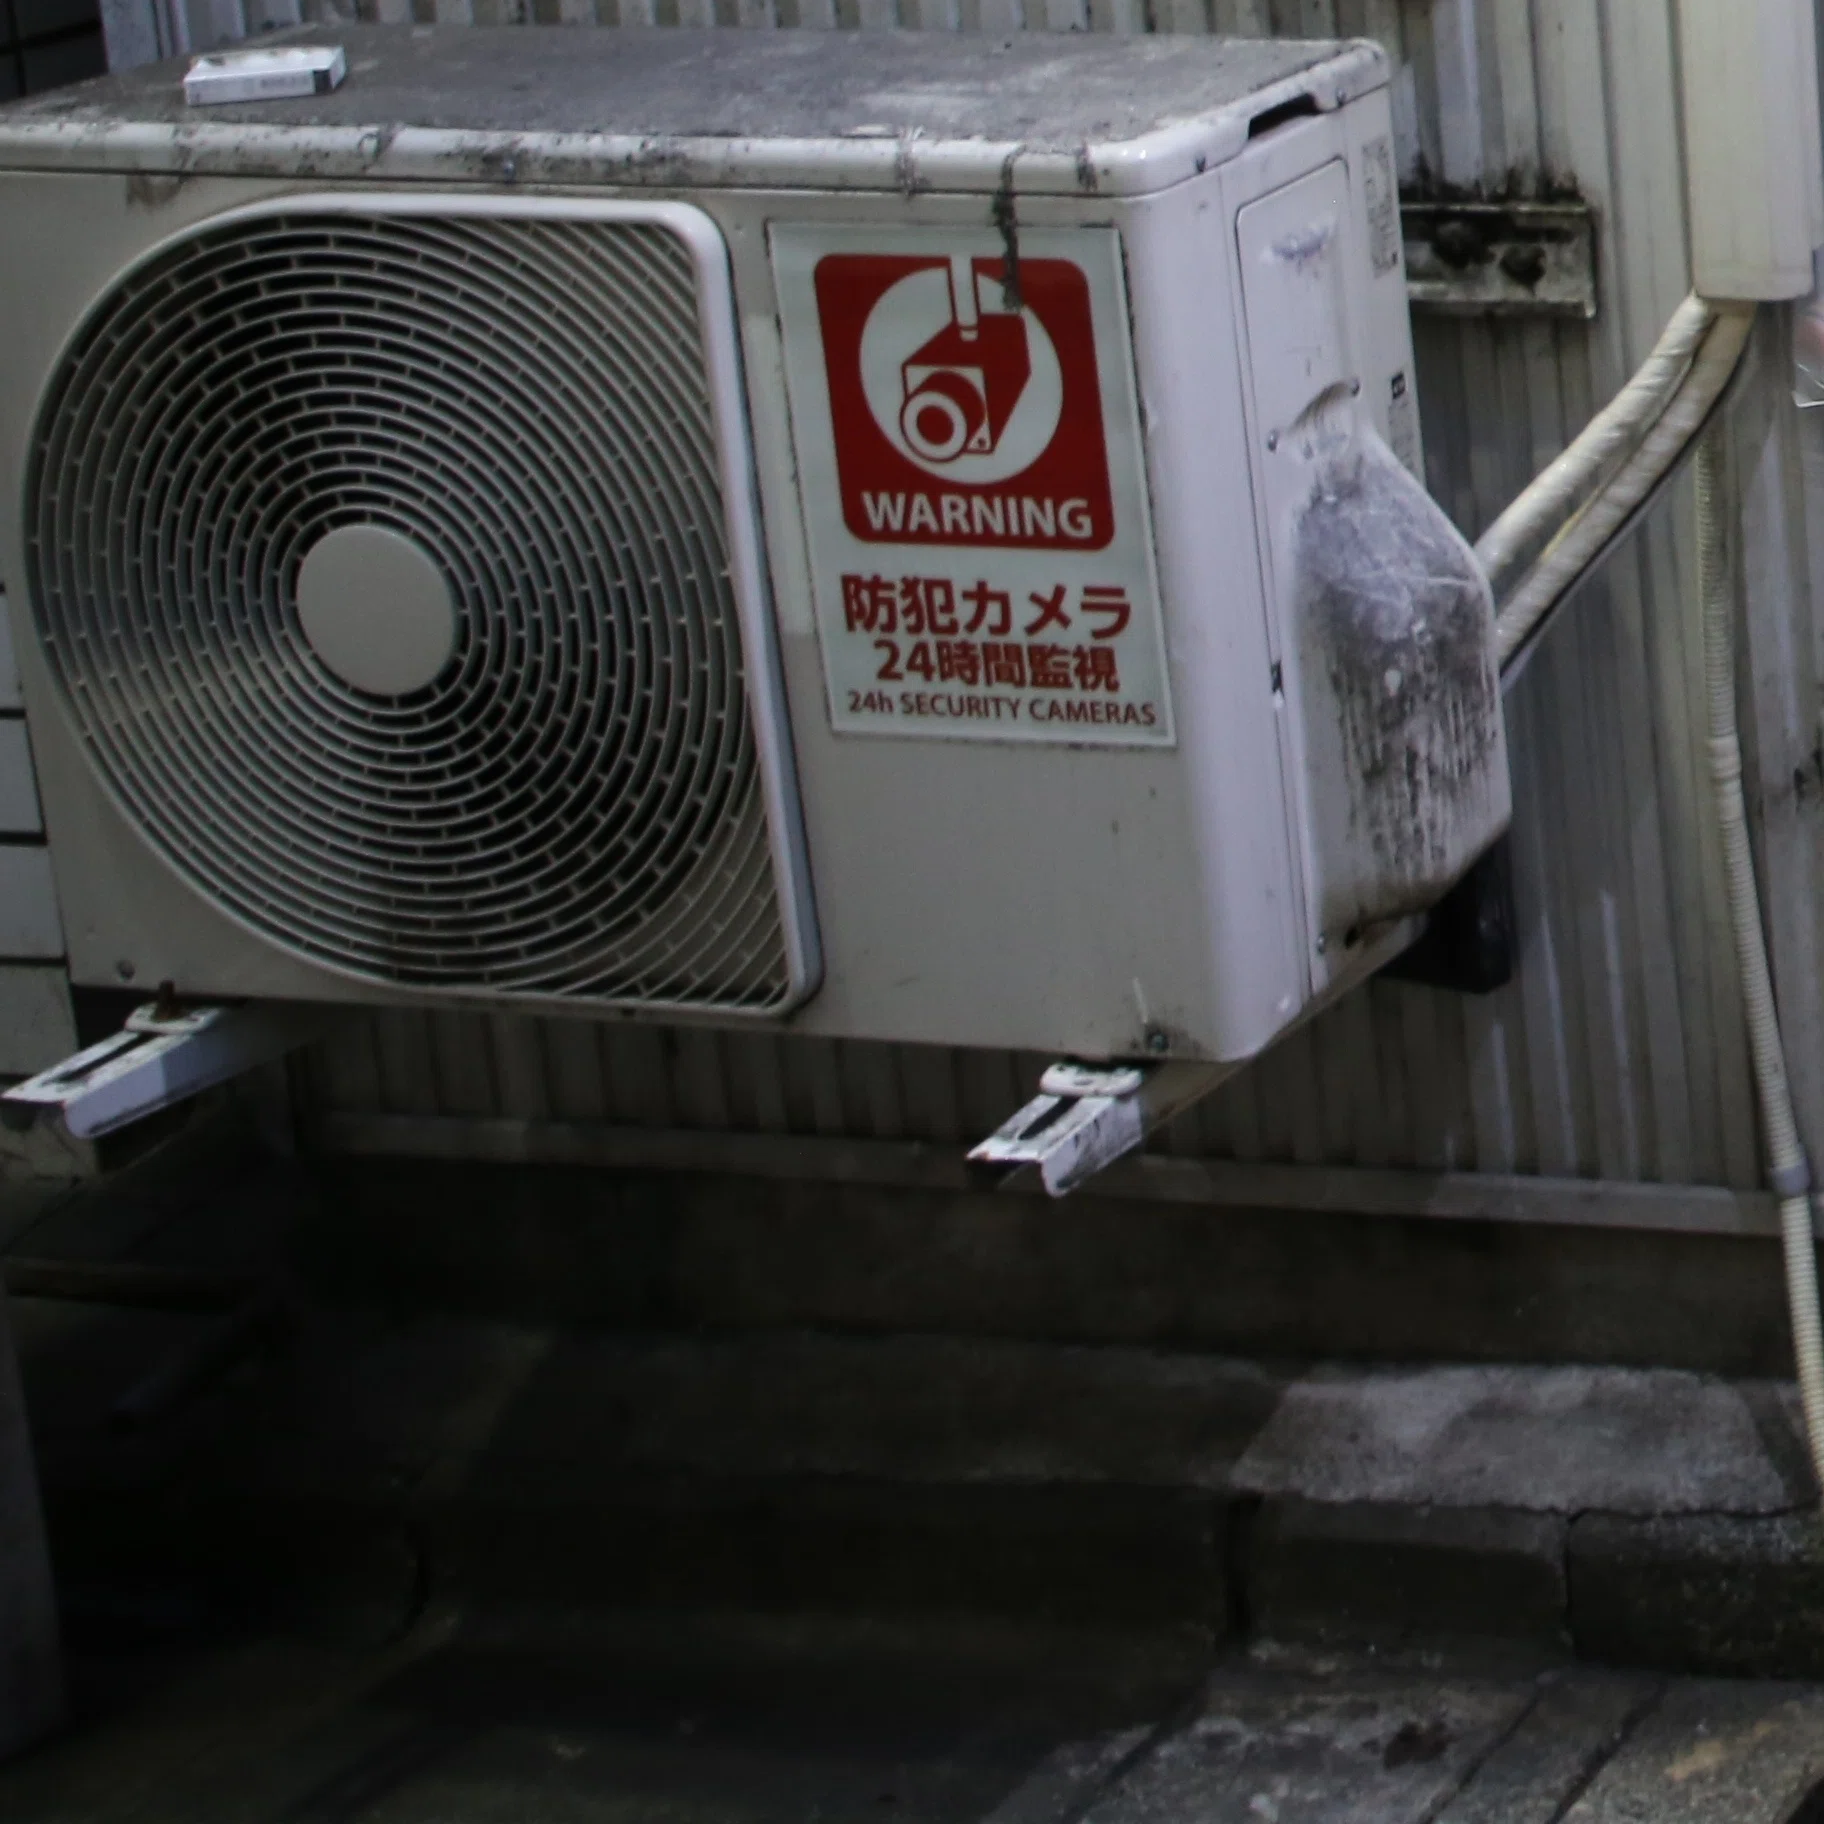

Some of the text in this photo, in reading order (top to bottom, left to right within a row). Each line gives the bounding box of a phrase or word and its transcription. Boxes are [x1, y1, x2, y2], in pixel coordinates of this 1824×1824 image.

[862, 490, 1093, 540] WARNING
[841, 573, 1133, 641] 防犯カメラ
[874, 639, 1121, 693] 24時間監視
[848, 690, 1156, 727] 24h SECURITY CAMERAS
